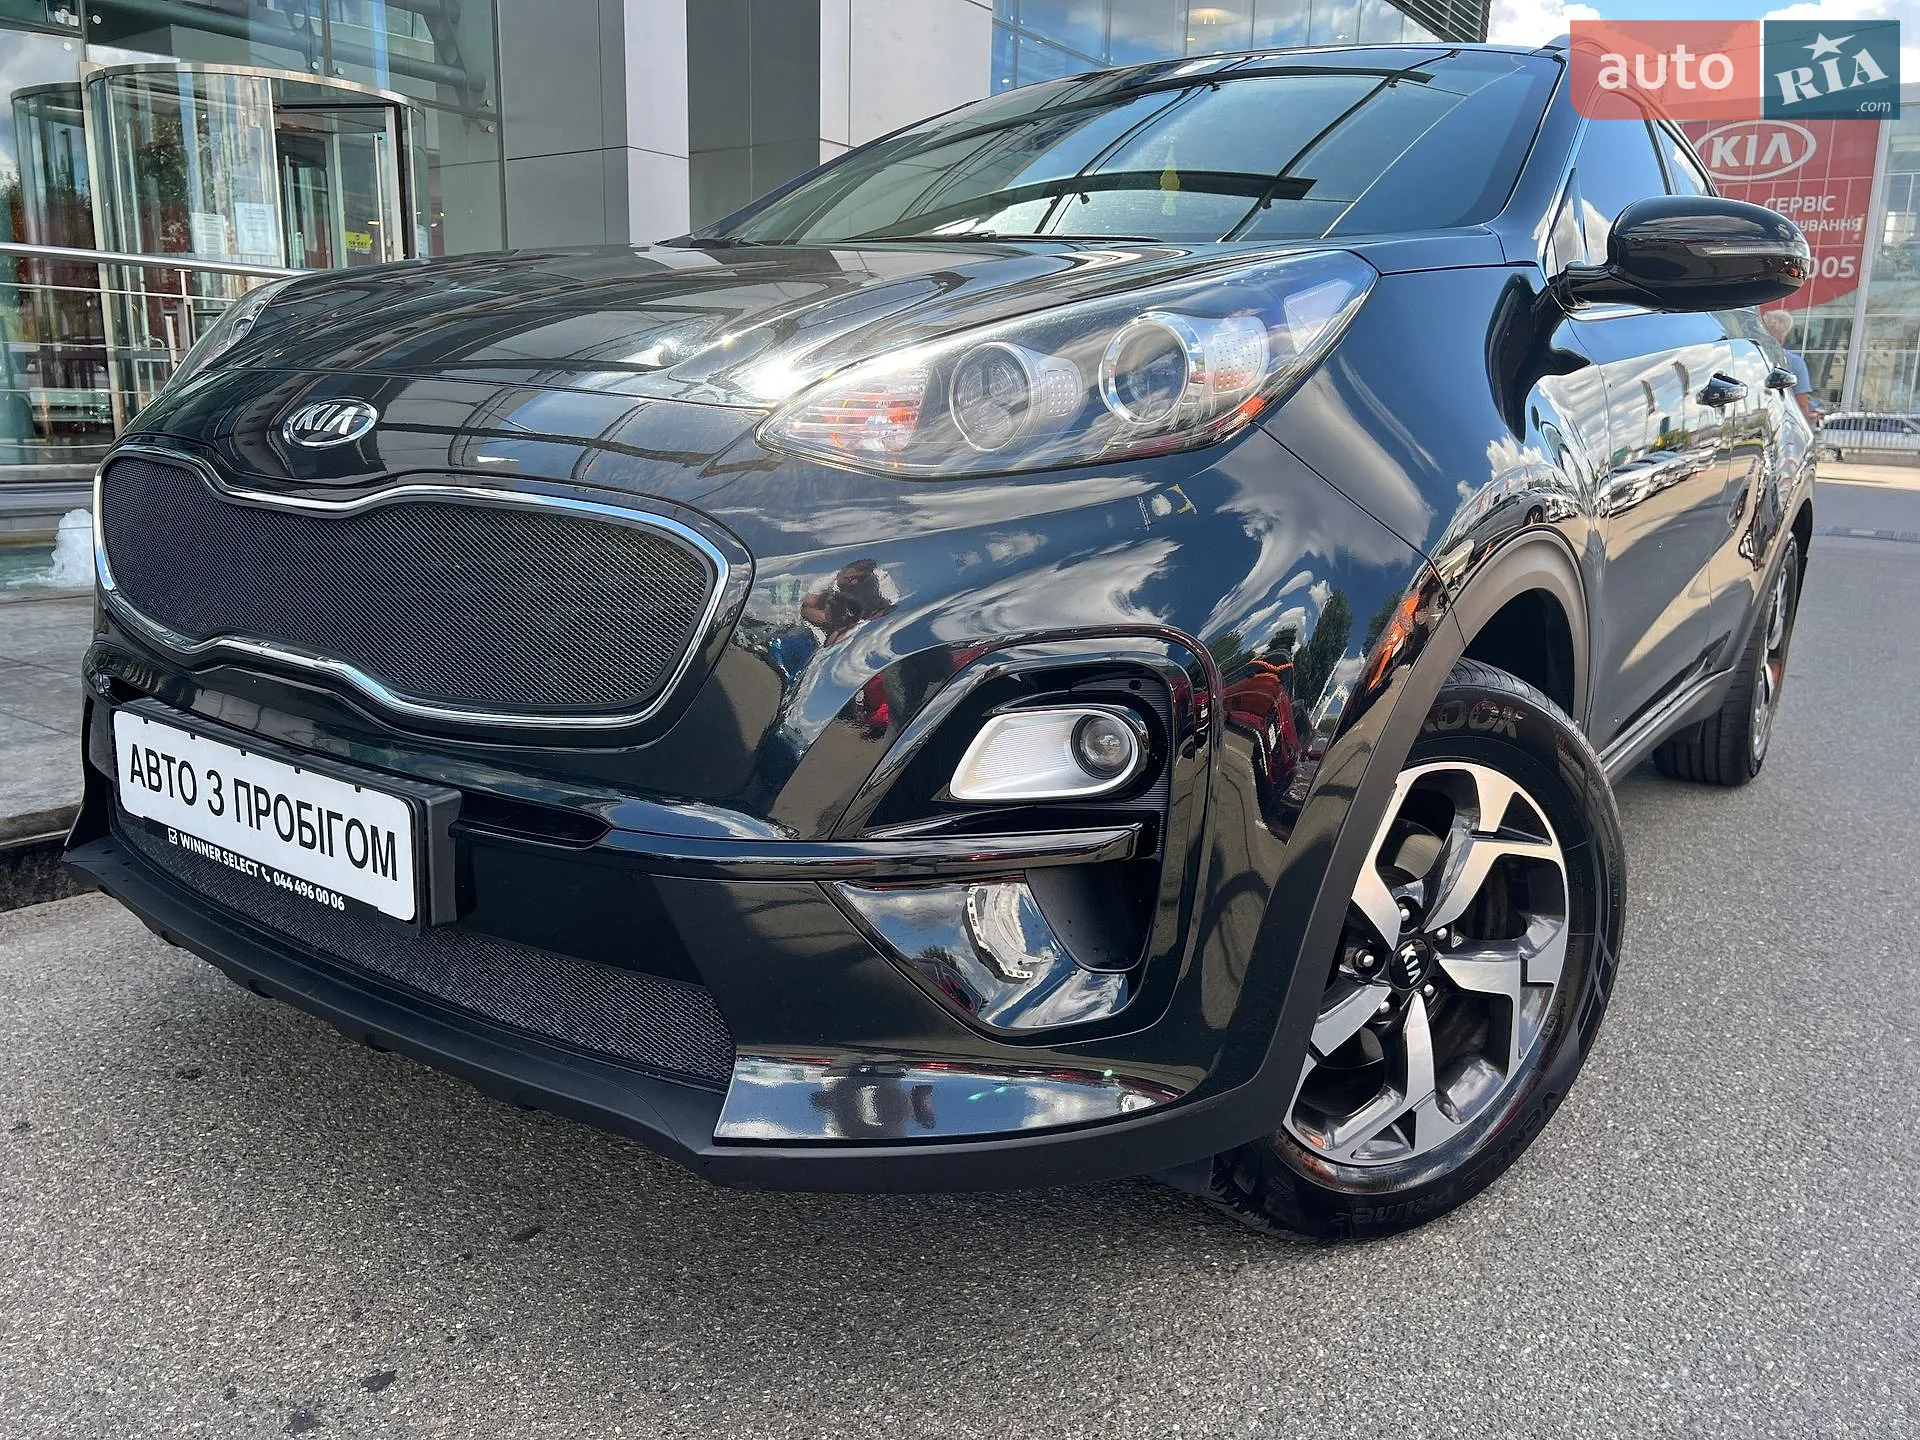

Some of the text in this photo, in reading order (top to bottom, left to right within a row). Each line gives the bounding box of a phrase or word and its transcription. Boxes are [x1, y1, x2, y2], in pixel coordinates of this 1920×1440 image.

[1710, 132, 1793, 168] KIA
[294, 404, 359, 435] KIA
[130, 743, 197, 806] АВТО
[233, 778, 398, 882] ПРОБІГОМ
[180, 833, 345, 911] WINNER SELECT 044 496 00 06
[1400, 943, 1421, 984] KIA
